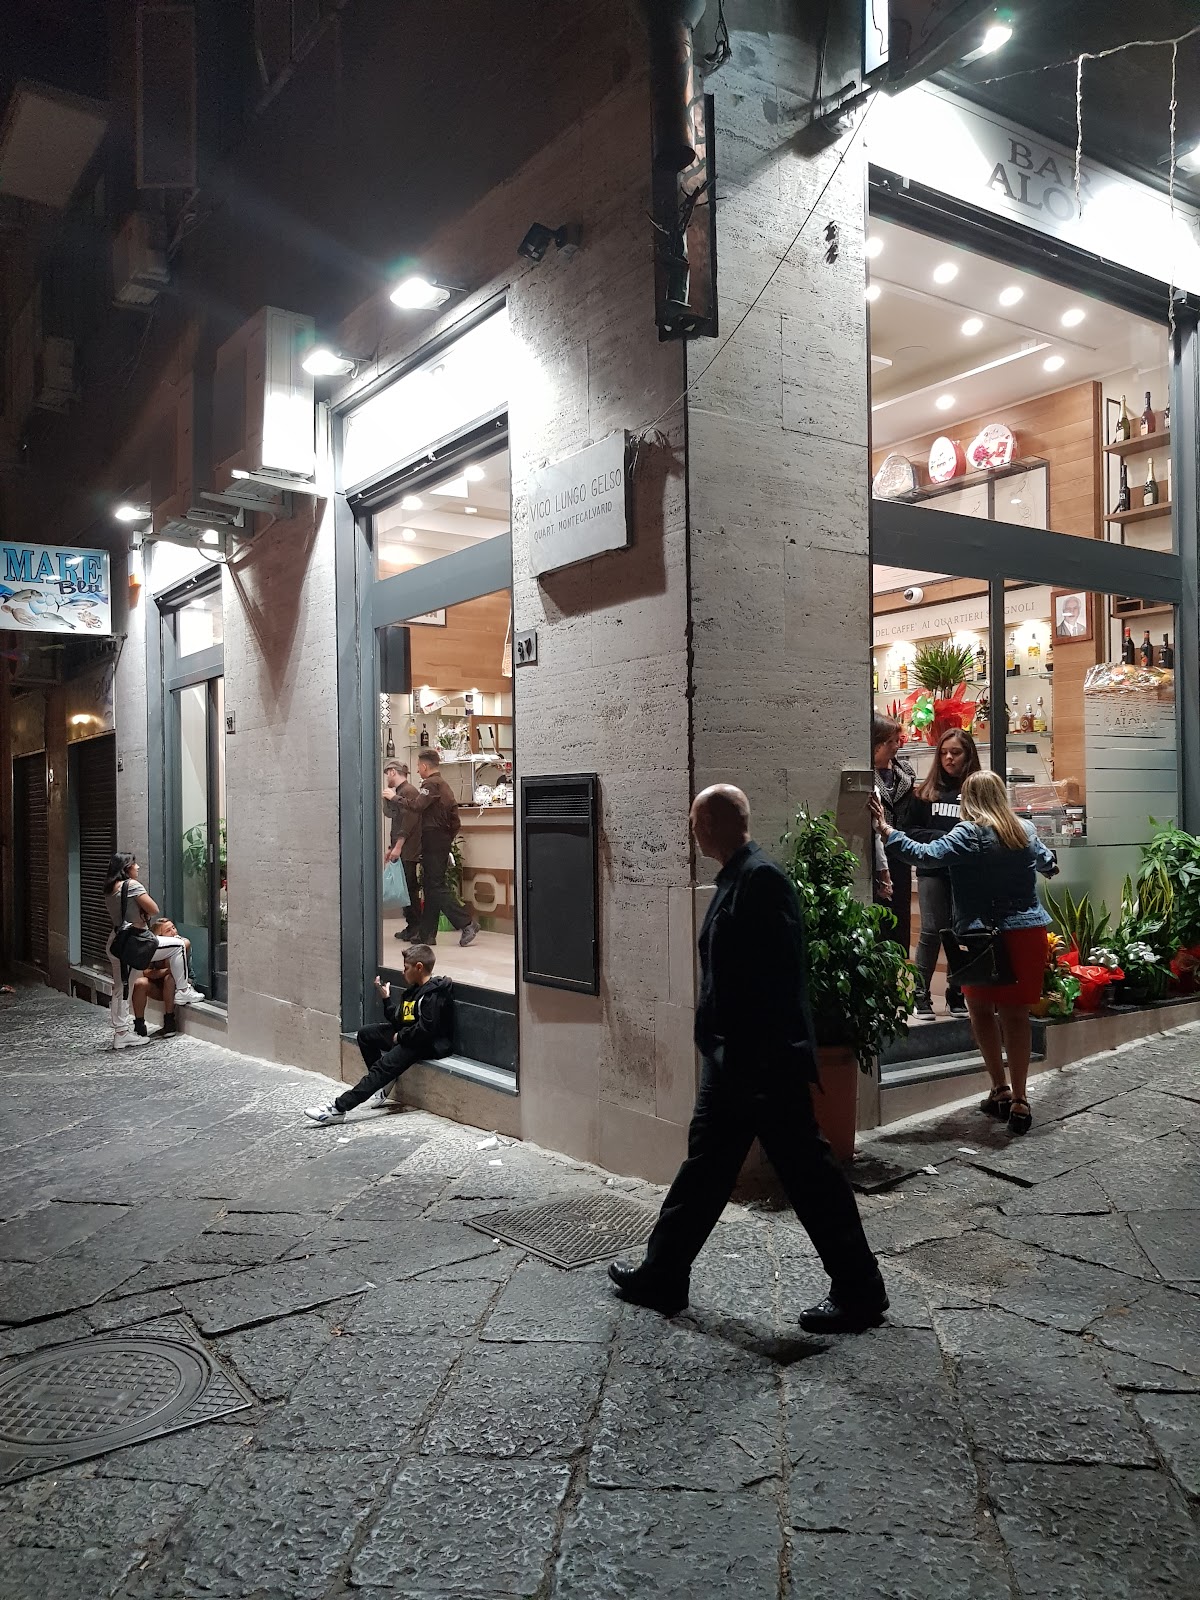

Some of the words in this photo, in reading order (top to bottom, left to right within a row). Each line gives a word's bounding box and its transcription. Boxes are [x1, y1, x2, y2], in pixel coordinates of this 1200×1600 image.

[1007, 137, 1094, 199] BAR
[985, 162, 1080, 222] ALO
[530, 498, 551, 522] VICO
[555, 483, 587, 513] LUNGO
[591, 468, 622, 497] GELSO
[534, 524, 556, 543] QUART.
[558, 501, 613, 532] MONTECALVARIO
[3, 548, 102, 586] MARE
[54, 577, 103, 594] Blu
[875, 626, 890, 638] DEL
[921, 620, 930, 629] AI
[933, 612, 984, 628] QUARTIERI
[985, 602, 1035, 620] SGNOLI
[931, 802, 961, 818] PUM
